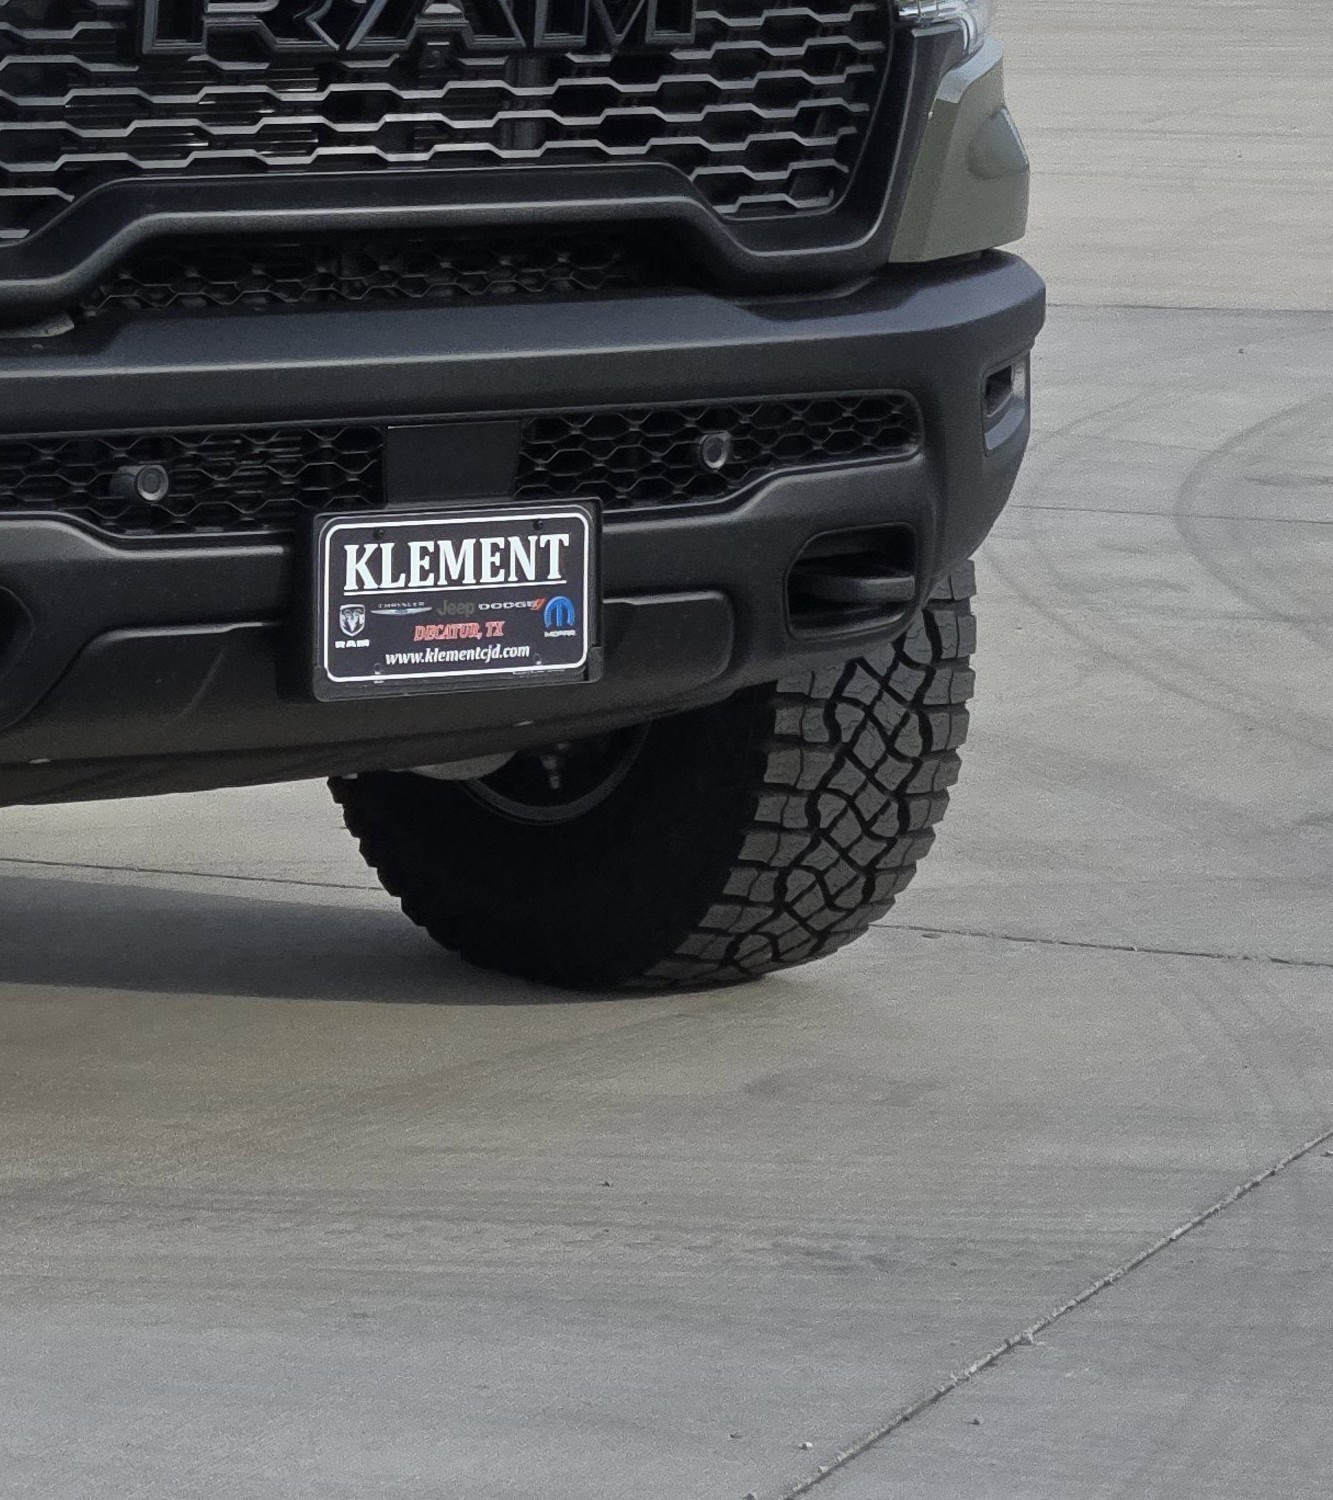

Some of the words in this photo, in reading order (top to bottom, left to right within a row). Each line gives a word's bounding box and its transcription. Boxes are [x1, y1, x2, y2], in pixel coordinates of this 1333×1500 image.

[343, 533, 570, 591] KLEMENT
[436, 599, 476, 618] Jeep
[478, 600, 537, 611] DODGE
[486, 620, 506, 638] TX
[335, 639, 370, 649] RAM
[385, 644, 530, 665] www.klementcjd.com
